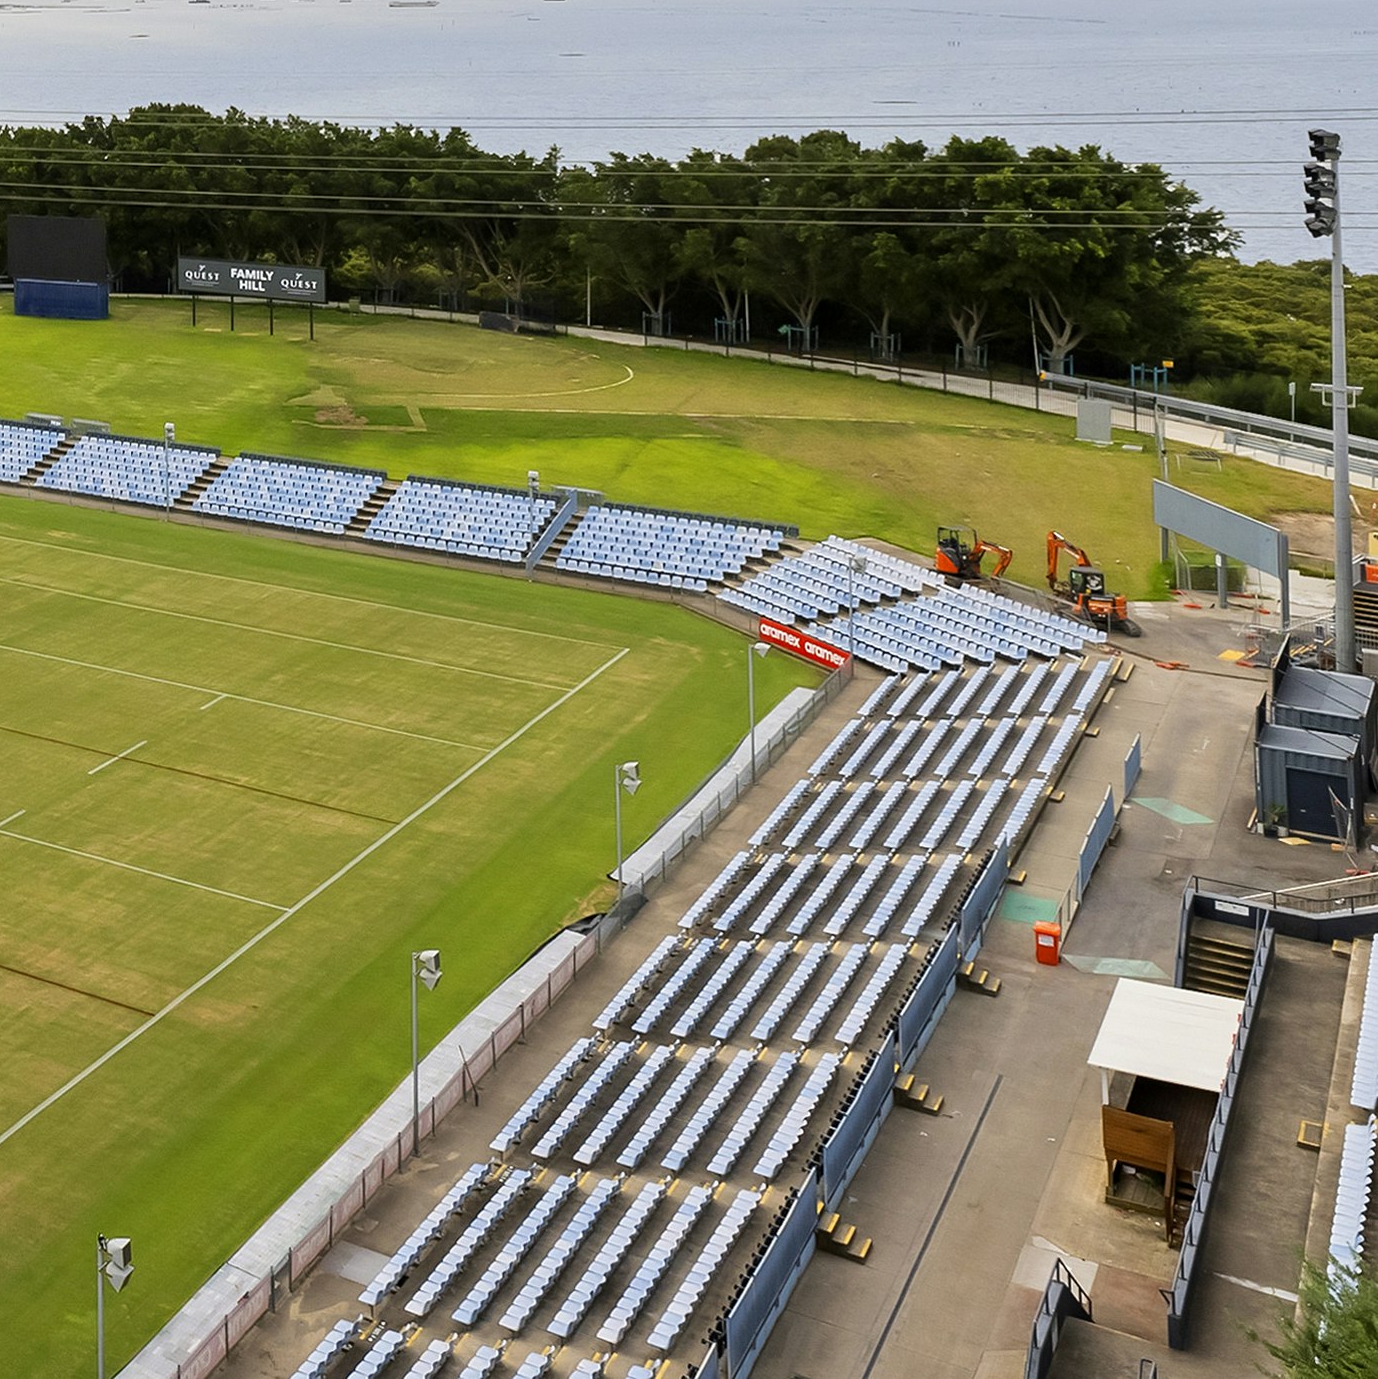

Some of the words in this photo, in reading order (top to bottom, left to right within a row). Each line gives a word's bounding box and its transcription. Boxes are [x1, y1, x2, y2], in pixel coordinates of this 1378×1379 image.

[185, 270, 220, 281] QUEST
[230, 268, 274, 281] FAMILY
[239, 280, 266, 292] HILL
[280, 278, 318, 290] QUEST
[760, 623, 801, 648] aramex
[804, 641, 845, 665] aramex
